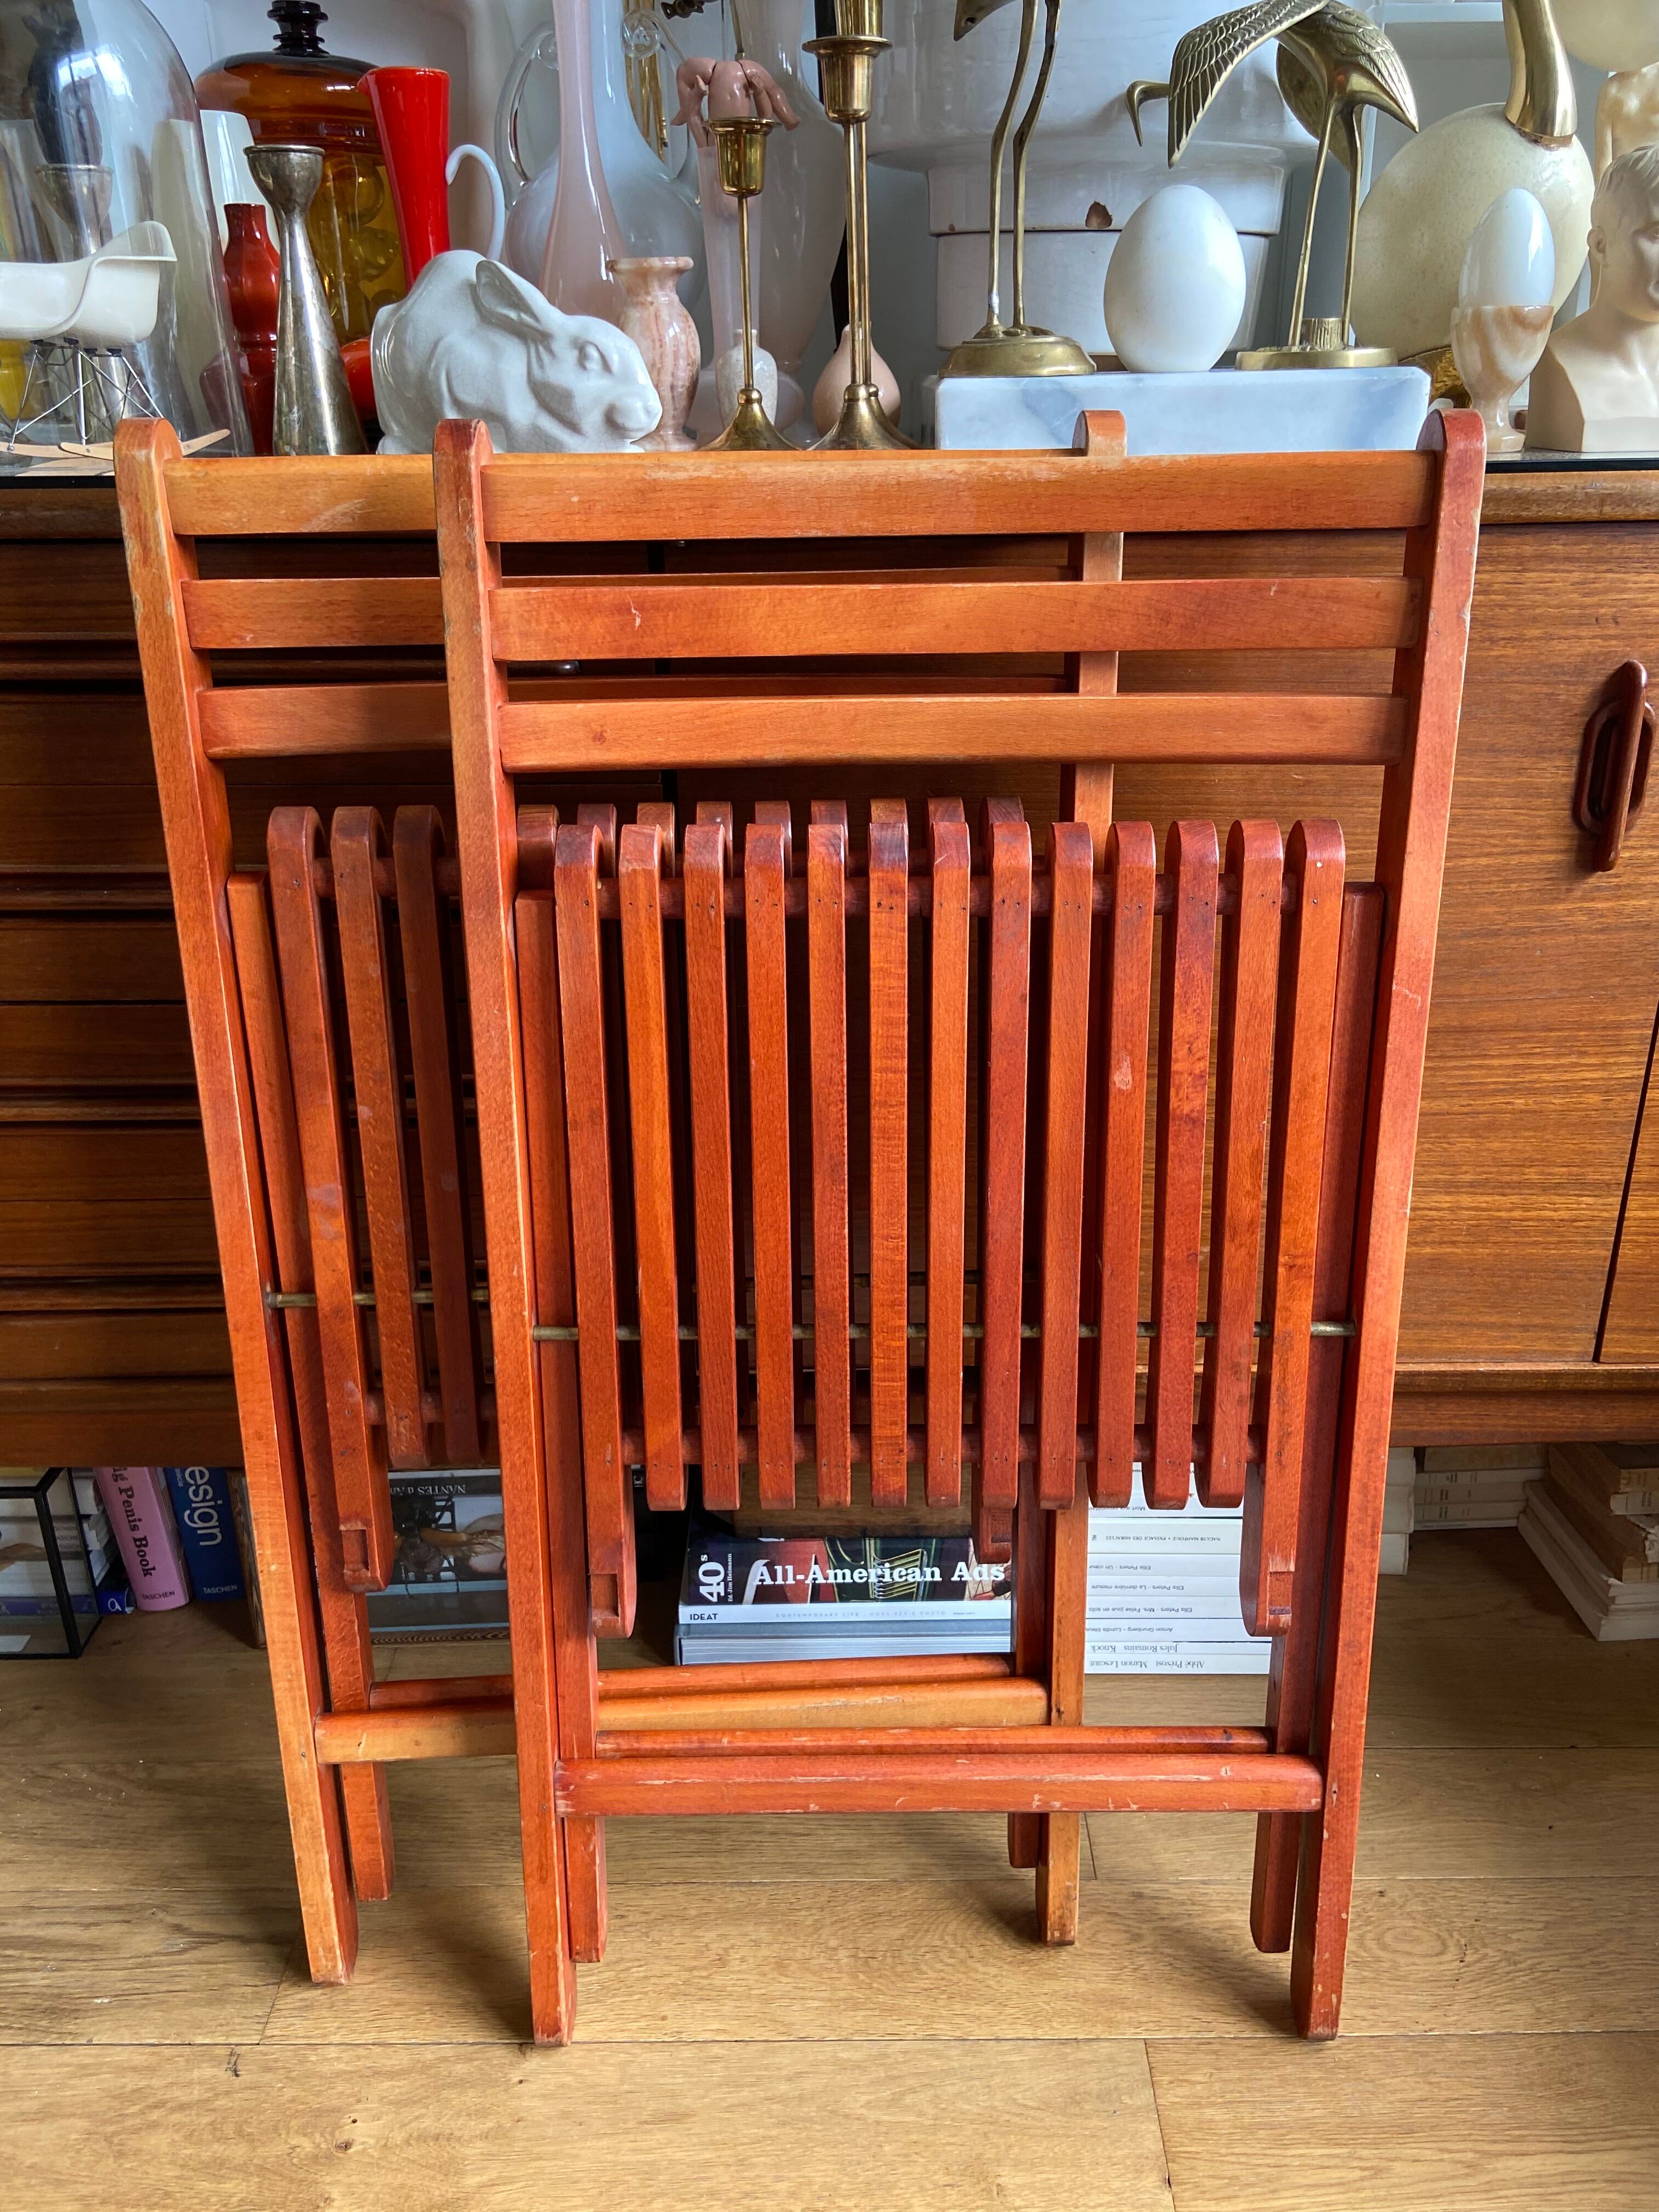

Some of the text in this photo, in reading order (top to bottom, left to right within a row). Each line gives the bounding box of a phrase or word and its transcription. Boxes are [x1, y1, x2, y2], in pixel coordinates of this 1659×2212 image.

[417, 1485, 466, 1496] NANTES
[119, 1485, 143, 1532] Penis
[133, 1535, 156, 1578] Book
[752, 1561, 1005, 1585] All-American Ads
[202, 1584, 238, 1594] TASCHEN
[142, 1590, 176, 1601] TASCHEN
[1160, 1643, 1180, 1652] Jules
[1090, 1660, 1205, 1668] Abbé Prévost Manon Lescaut
